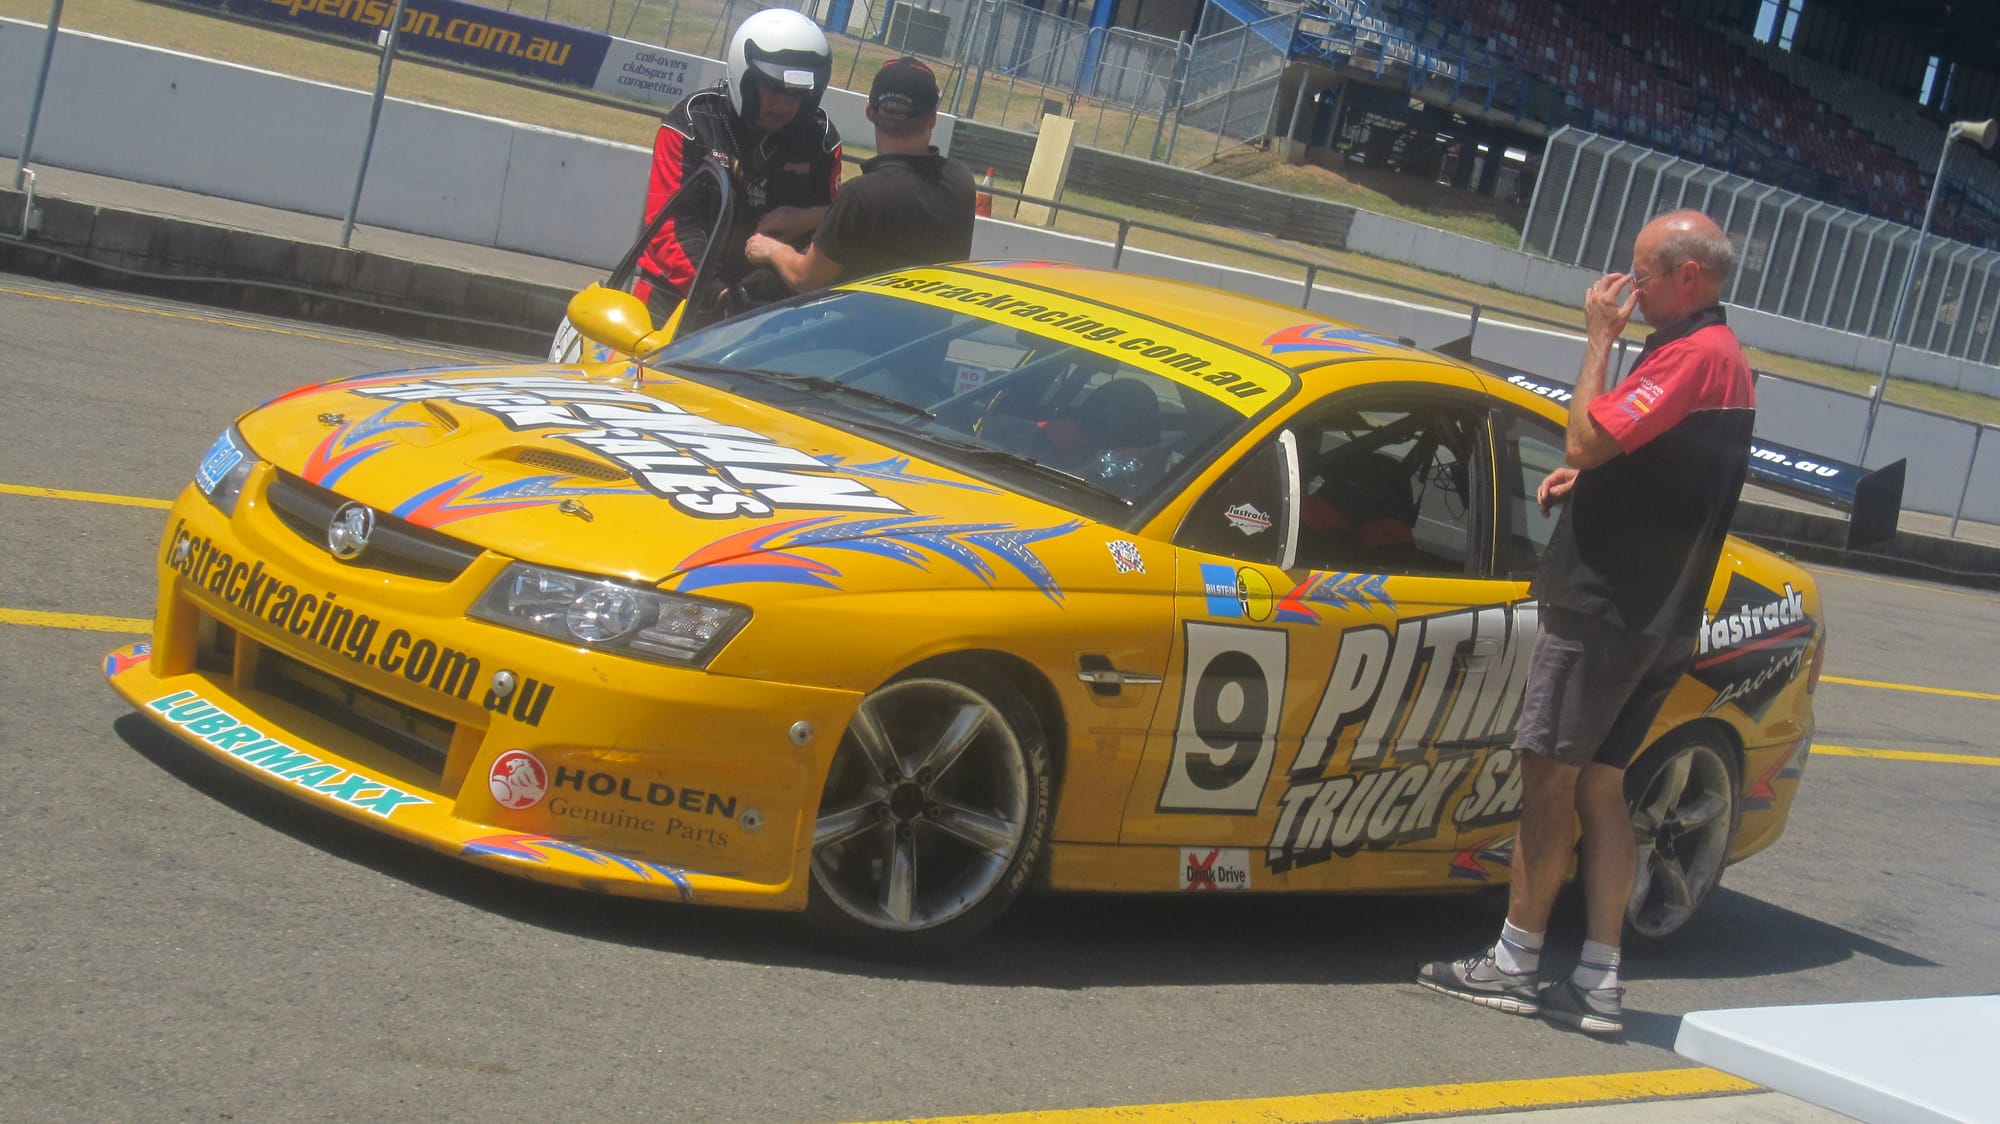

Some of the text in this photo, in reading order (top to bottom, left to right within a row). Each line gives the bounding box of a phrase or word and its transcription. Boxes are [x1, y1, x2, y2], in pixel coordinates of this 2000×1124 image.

[270, 0, 571, 66] pension.com.au
[635, 52, 688, 71] coil-overs
[617, 76, 684, 96] competition
[622, 62, 674, 80] clubsport
[863, 275, 1268, 398] fastrackracing.com.au
[1700, 583, 1804, 655] fastrack
[1185, 651, 1269, 790] 9
[1291, 601, 1540, 772] PITM
[147, 690, 432, 818] LUBRIMAXX
[548, 797, 729, 846] Genuine Parts
[554, 766, 737, 818] HOLDEN
[1268, 750, 1523, 861] TRUCK SA
[1010, 776, 1049, 890] MICHELIN
[1217, 866, 1246, 882] Drive
